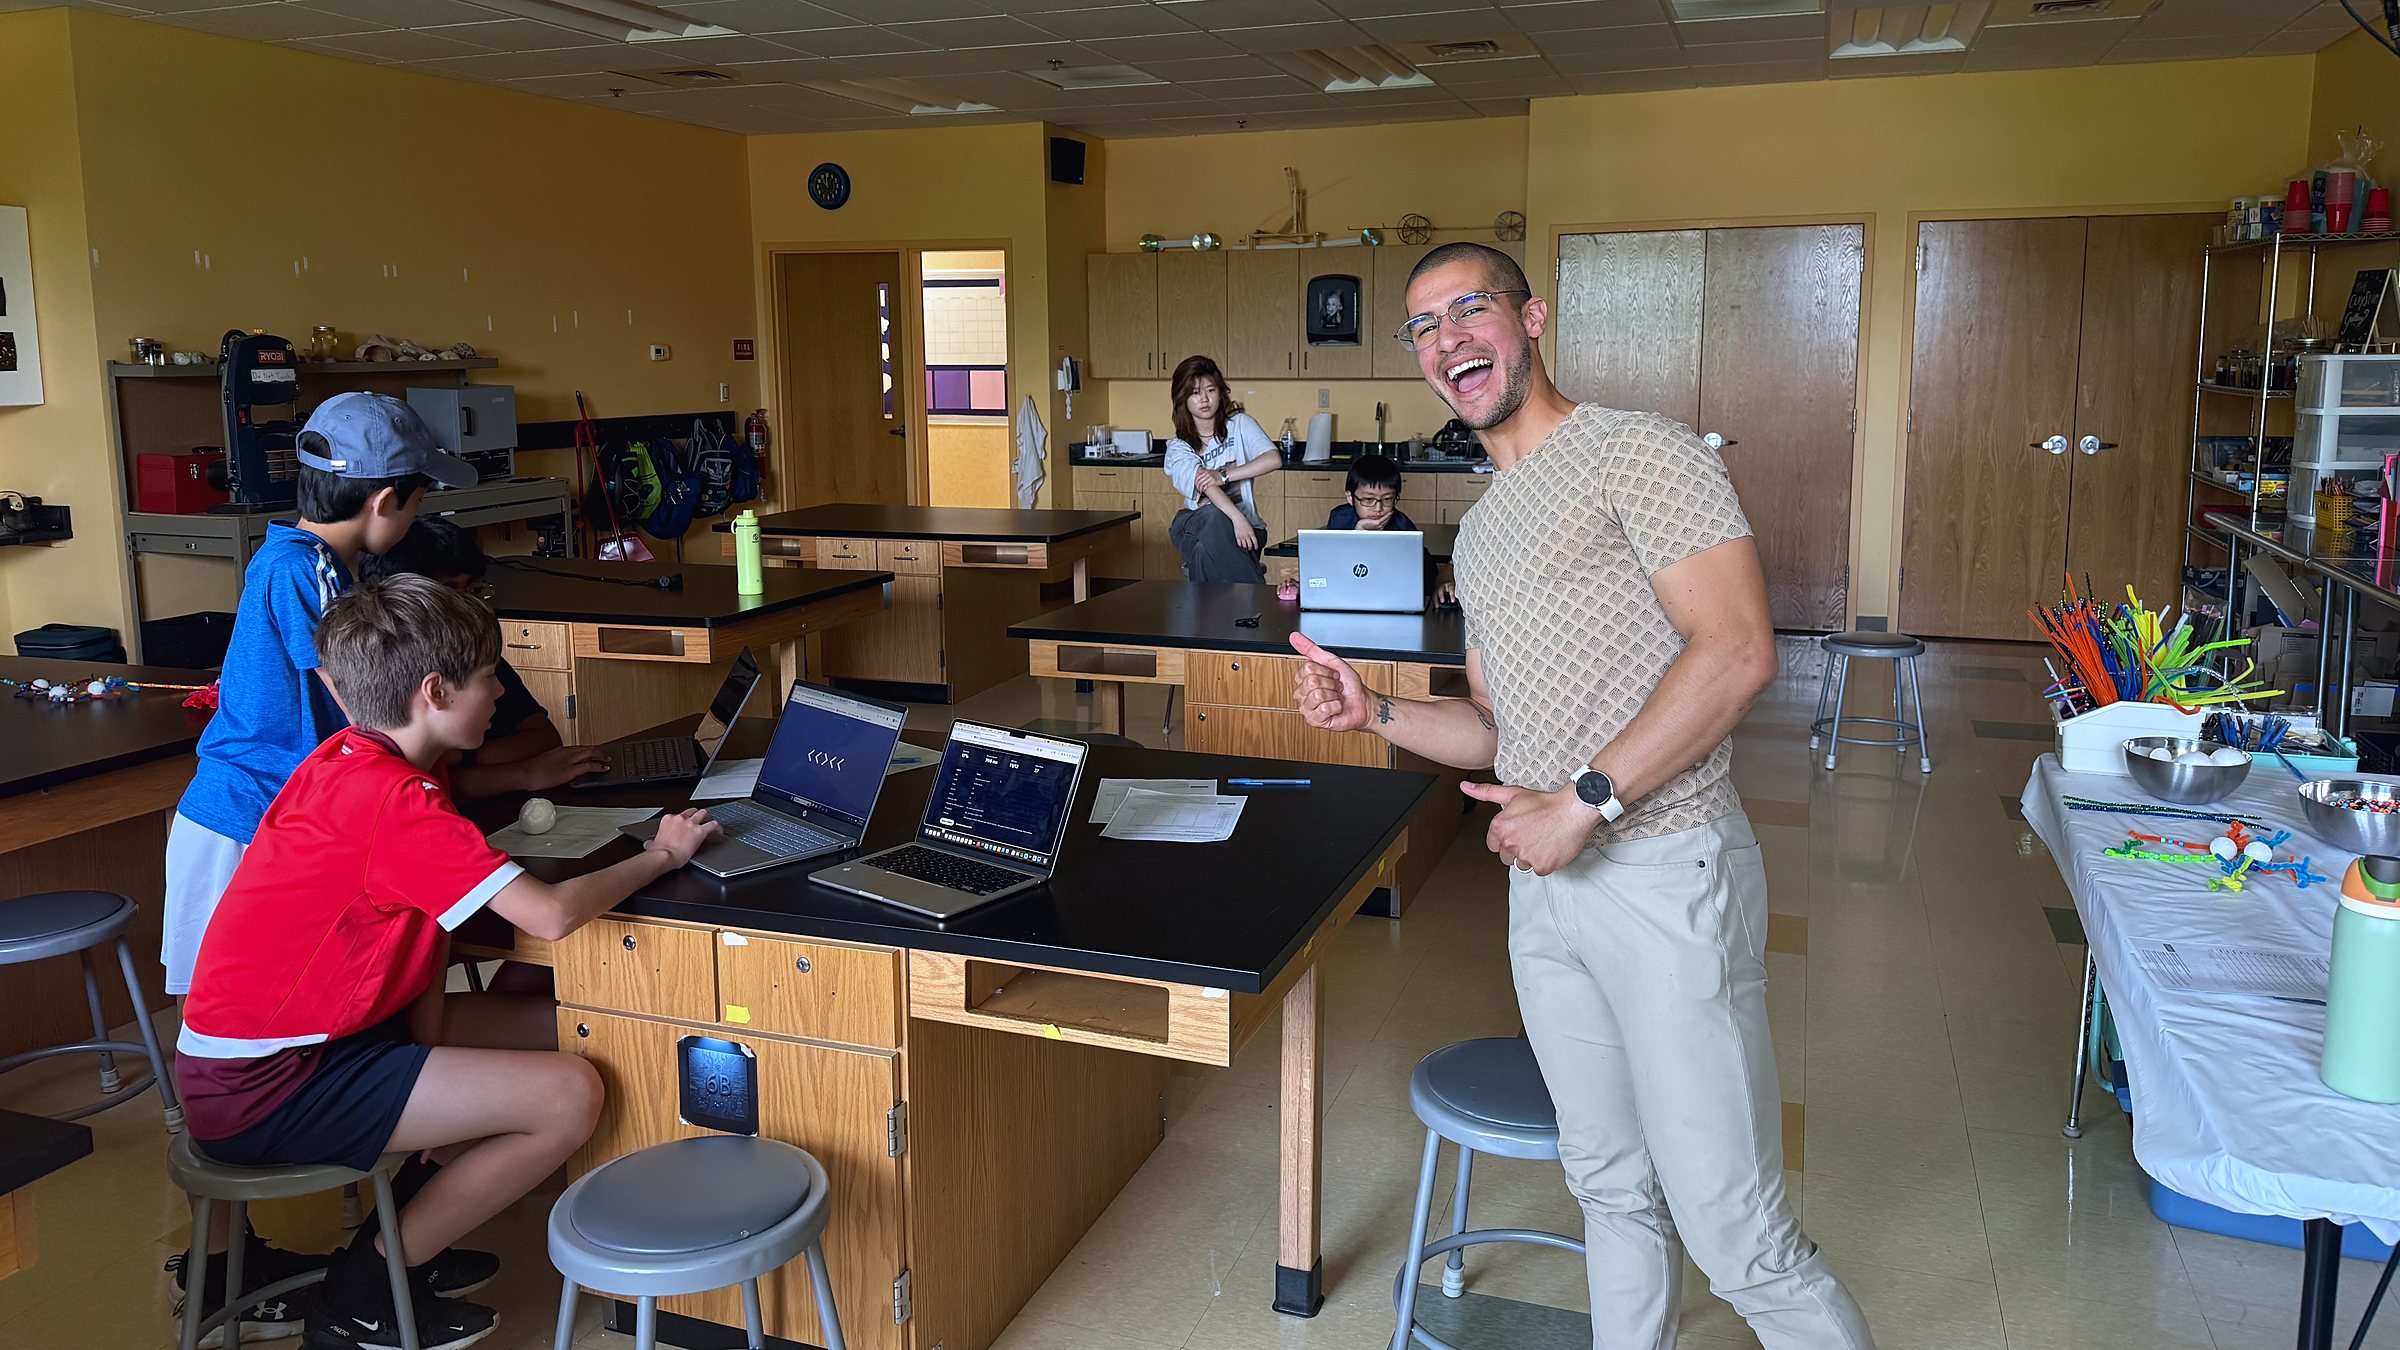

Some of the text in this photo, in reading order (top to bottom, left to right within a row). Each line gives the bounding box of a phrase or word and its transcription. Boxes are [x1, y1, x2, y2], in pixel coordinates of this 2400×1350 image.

[259, 352, 285, 361] RYOBI
[1354, 563, 1367, 578] hp
[706, 1073, 732, 1097] 6B
